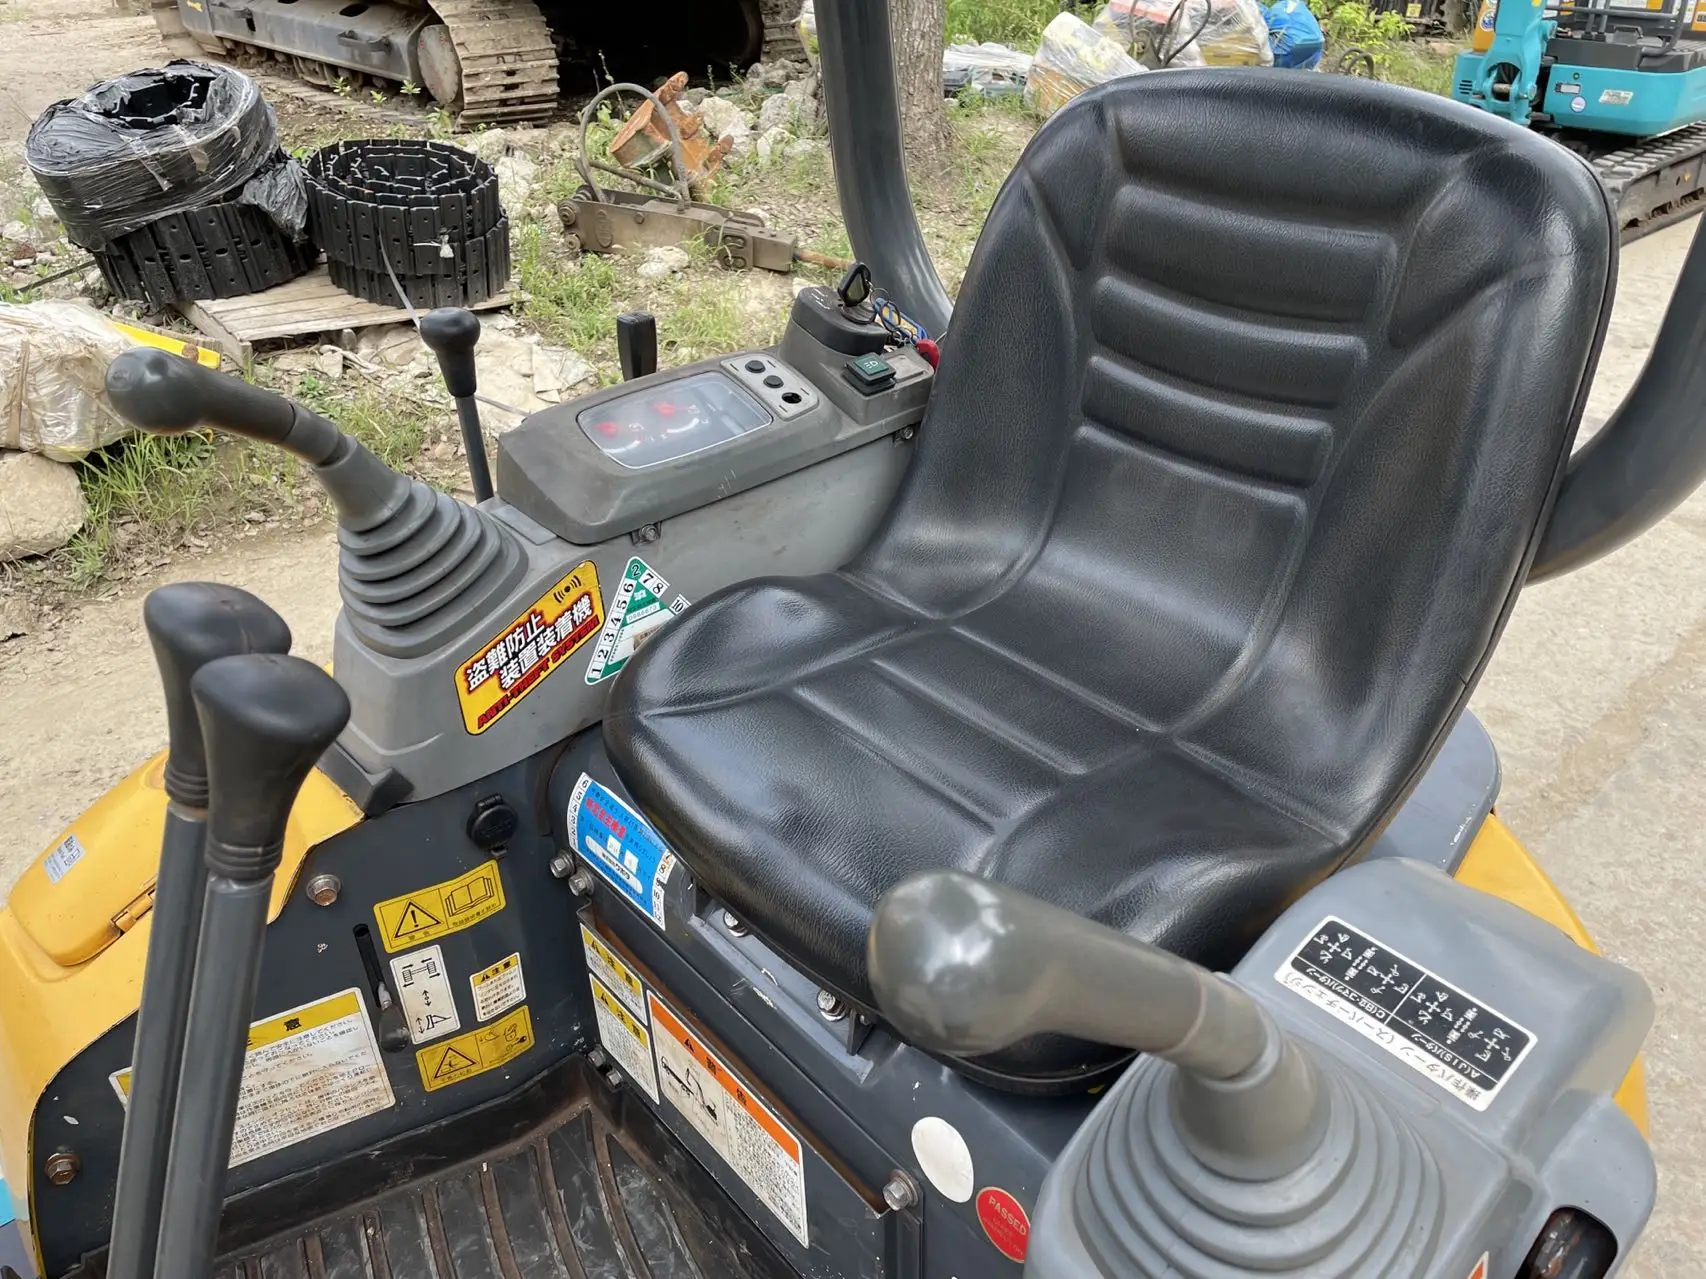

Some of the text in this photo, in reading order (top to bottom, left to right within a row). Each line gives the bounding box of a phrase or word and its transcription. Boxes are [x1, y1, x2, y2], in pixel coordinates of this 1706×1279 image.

[631, 564, 640, 577] 2
[643, 573, 654, 584] 7
[653, 583, 663, 594] 8
[671, 600, 684, 613] 10
[467, 613, 545, 690] 盗難防止
[500, 595, 592, 690] 装置装着機
[591, 667, 601, 676] 1
[597, 649, 609, 660] 2
[603, 633, 614, 643] 3
[610, 617, 621, 627] 4
[617, 600, 627, 610] 5
[623, 583, 634, 593] 6
[477, 656, 550, 730] ANTI-THEFT
[551, 615, 600, 664] SYSTEM
[575, 791, 583, 800] 5
[582, 780, 589, 788] 6
[988, 1195, 1027, 1236] PASSED
